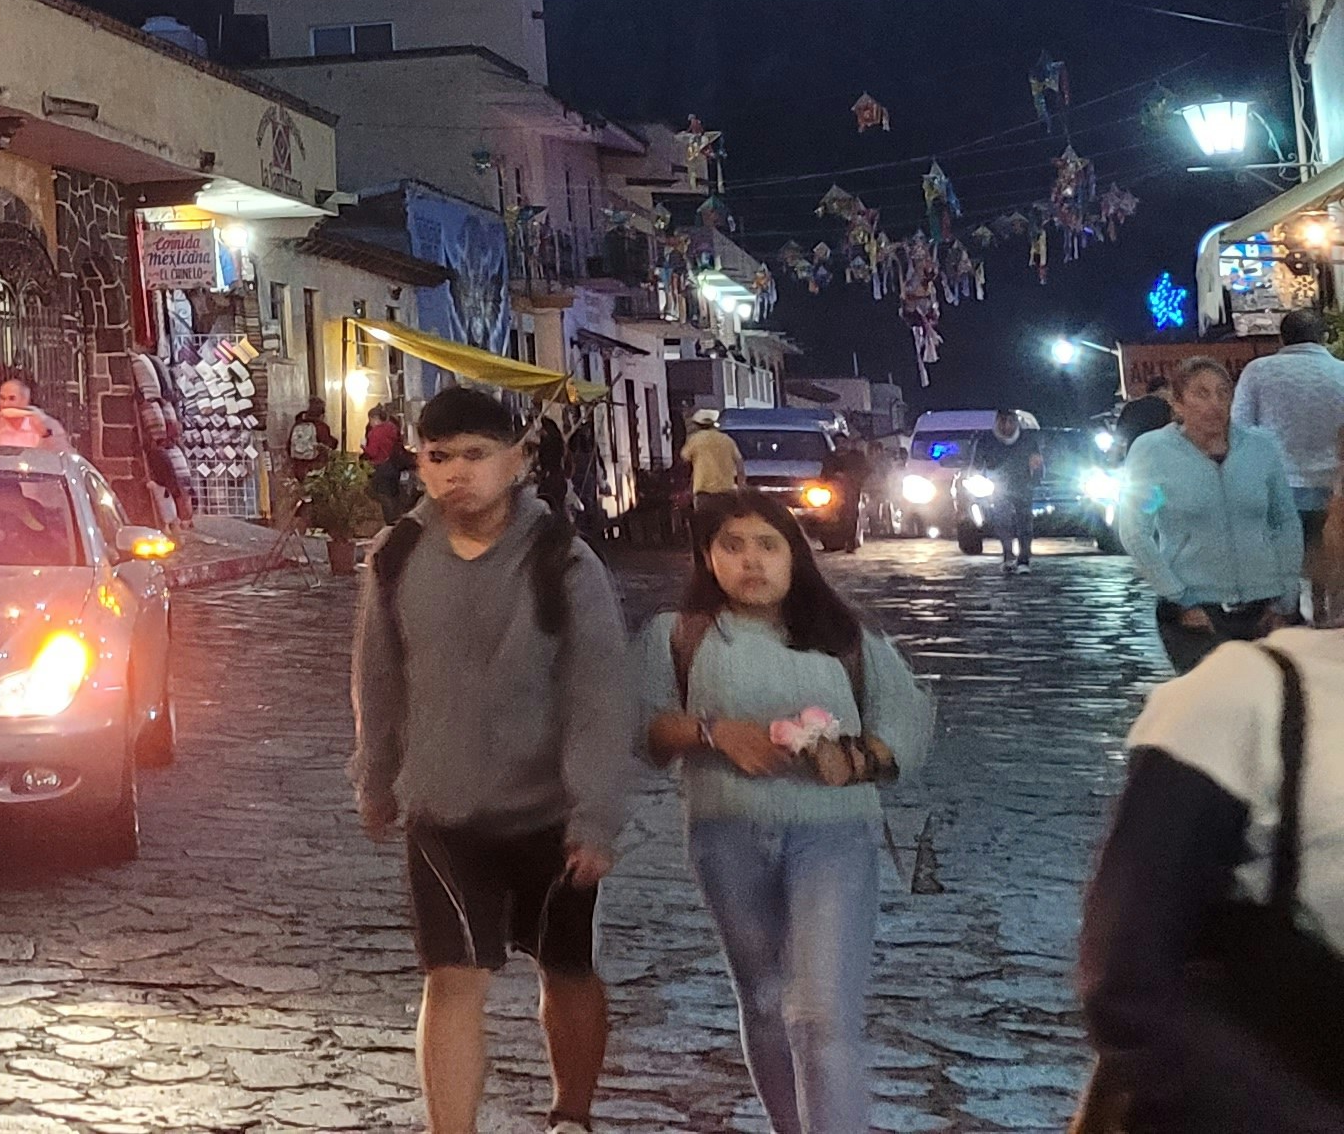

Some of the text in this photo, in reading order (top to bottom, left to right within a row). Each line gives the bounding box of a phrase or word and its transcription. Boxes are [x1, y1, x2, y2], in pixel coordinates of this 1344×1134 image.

[153, 234, 201, 251] Comida
[160, 267, 203, 280] EL CHINELO
